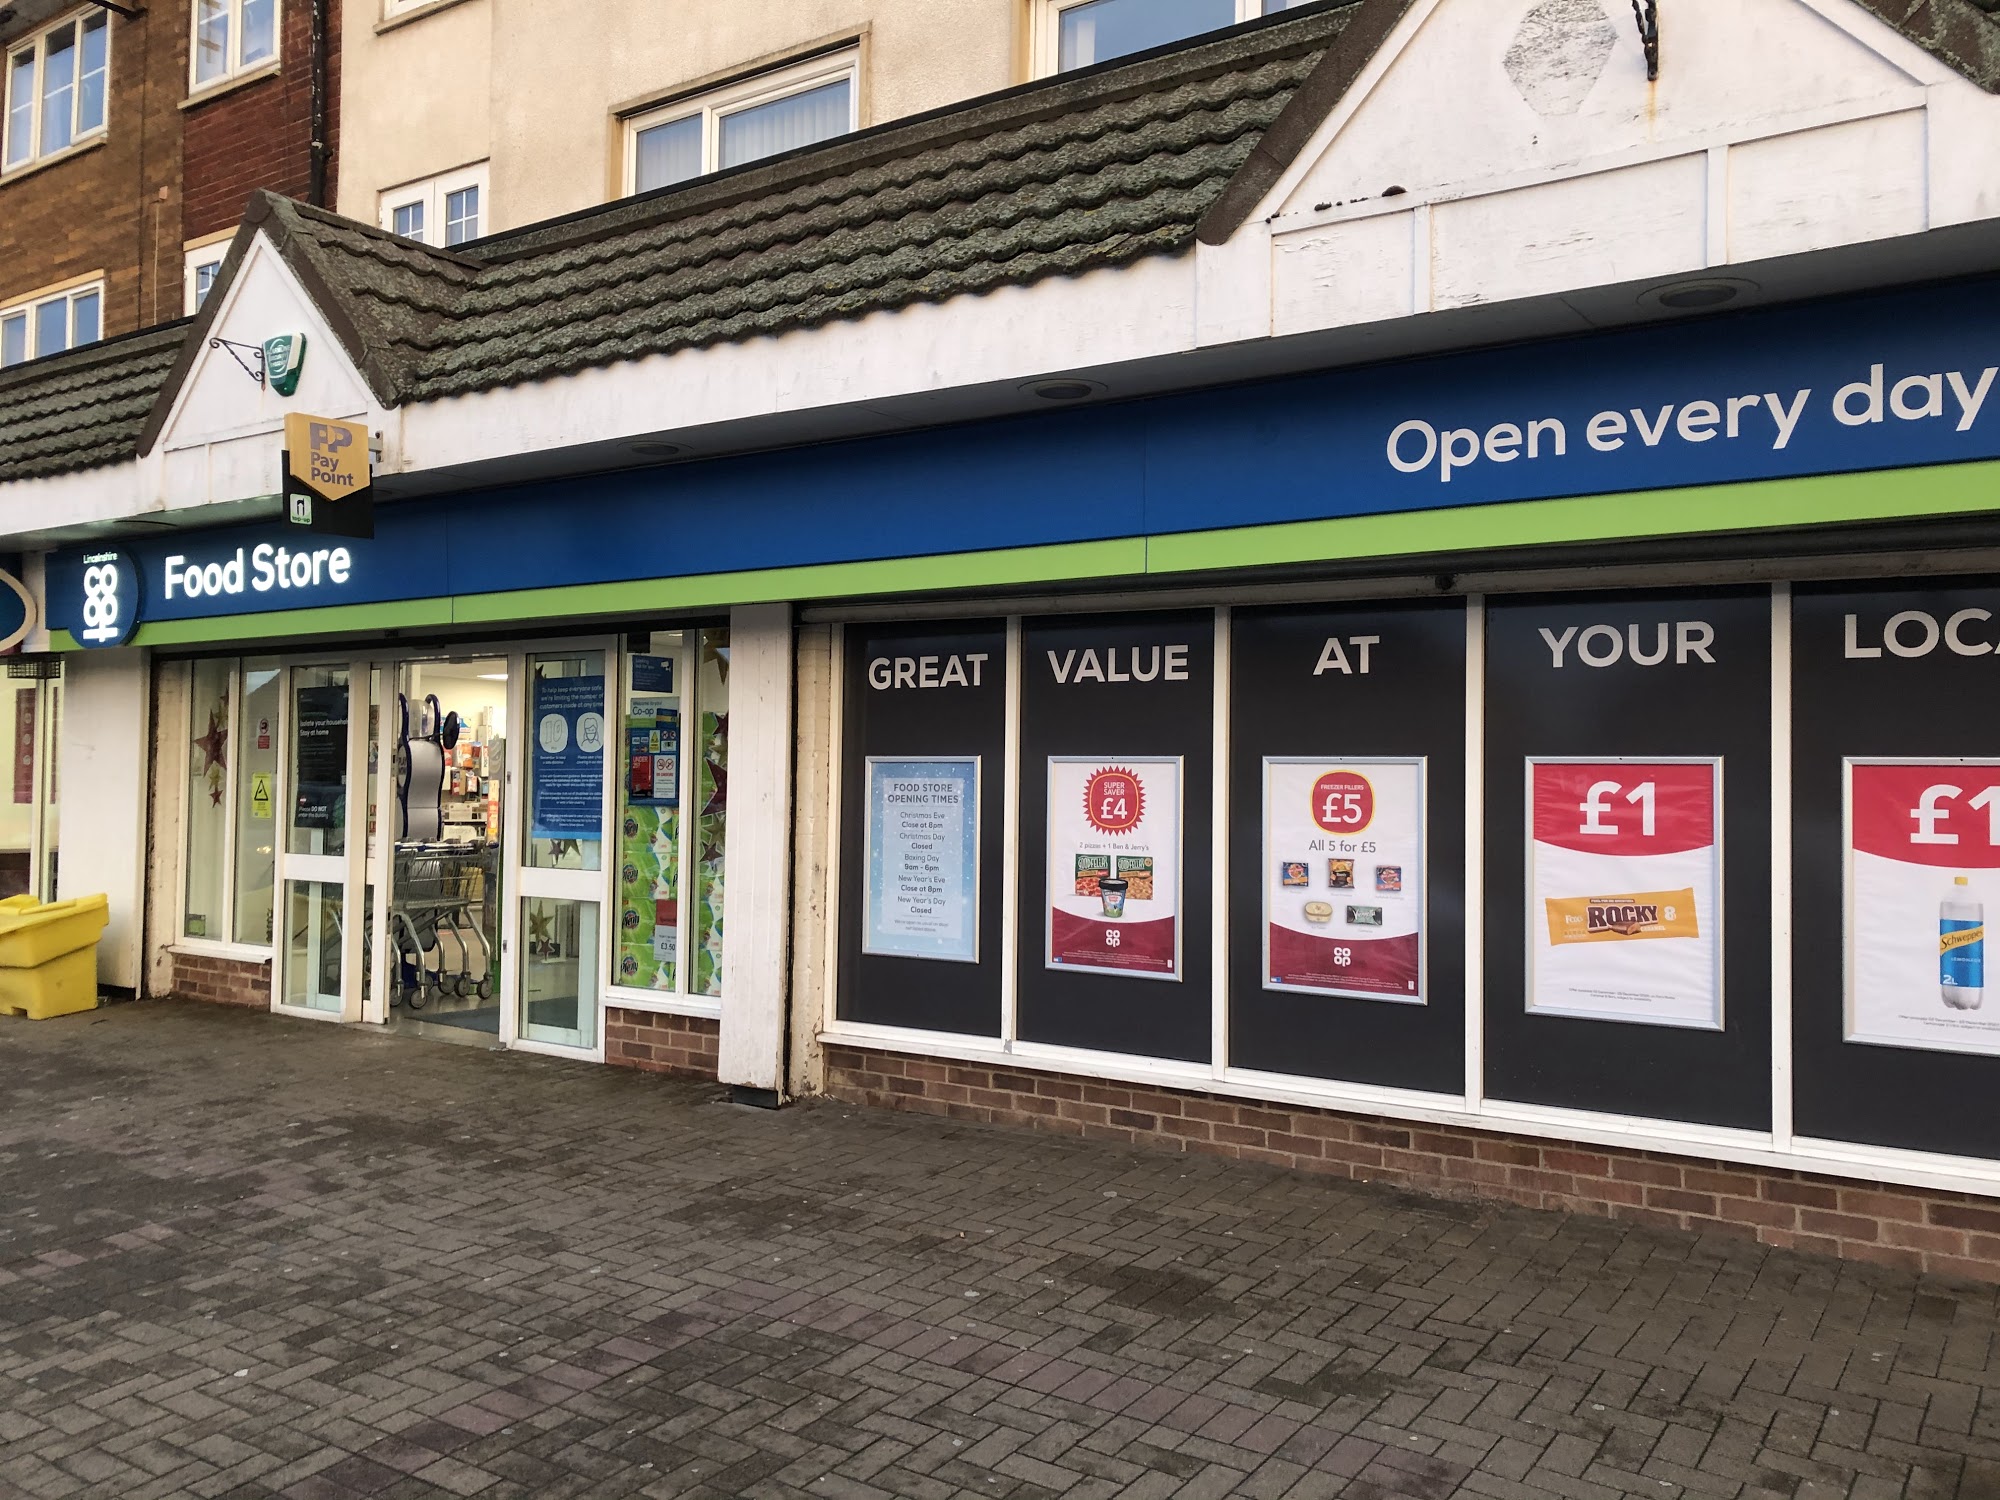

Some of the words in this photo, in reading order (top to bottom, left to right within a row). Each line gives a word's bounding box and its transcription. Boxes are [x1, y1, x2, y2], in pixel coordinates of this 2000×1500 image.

[1386, 418, 1566, 482] Open
[1586, 389, 1811, 451] every
[1832, 363, 2000, 431] day
[311, 452, 339, 472] Pay
[311, 466, 354, 486] Point
[83, 552, 117, 564] Lincolnshire
[165, 548, 244, 599] Food
[252, 543, 350, 591] Store
[868, 653, 989, 690] GREAT
[1047, 644, 1189, 684] VALUE
[1313, 636, 1380, 676] AT
[1538, 621, 1716, 668] YOUR
[1844, 608, 2000, 659] LOC
[633, 707, 654, 717] Co-op
[315, 720, 326, 729] your
[300, 729, 310, 737] Stay
[894, 784, 920, 792] FOOD
[923, 784, 953, 792] STORE
[888, 795, 929, 803] OPENING
[931, 795, 959, 804] TIMES
[1101, 798, 1127, 819] £4
[1322, 793, 1362, 824] £5
[1579, 780, 1656, 836] £1
[1910, 784, 2000, 846] £1
[928, 822, 943, 830] 8pm
[933, 834, 946, 842] Day
[1084, 842, 1101, 850] pizzas
[1309, 840, 1325, 851] All
[1329, 841, 1336, 851] 5
[1340, 840, 1357, 852] for
[1361, 842, 1376, 853] £5
[904, 854, 926, 863] Boxing
[925, 864, 940, 872] 6pm
[914, 875, 932, 883] Year's
[928, 886, 943, 894] 8pm
[913, 897, 932, 905] Year's
[933, 898, 946, 906] Day
[1587, 905, 1658, 929] ROCKY
[1664, 906, 1676, 921] 8
[1941, 930, 1983, 949] Schweppes
[661, 943, 675, 951] £3.50
[1943, 975, 1958, 985] 2L
